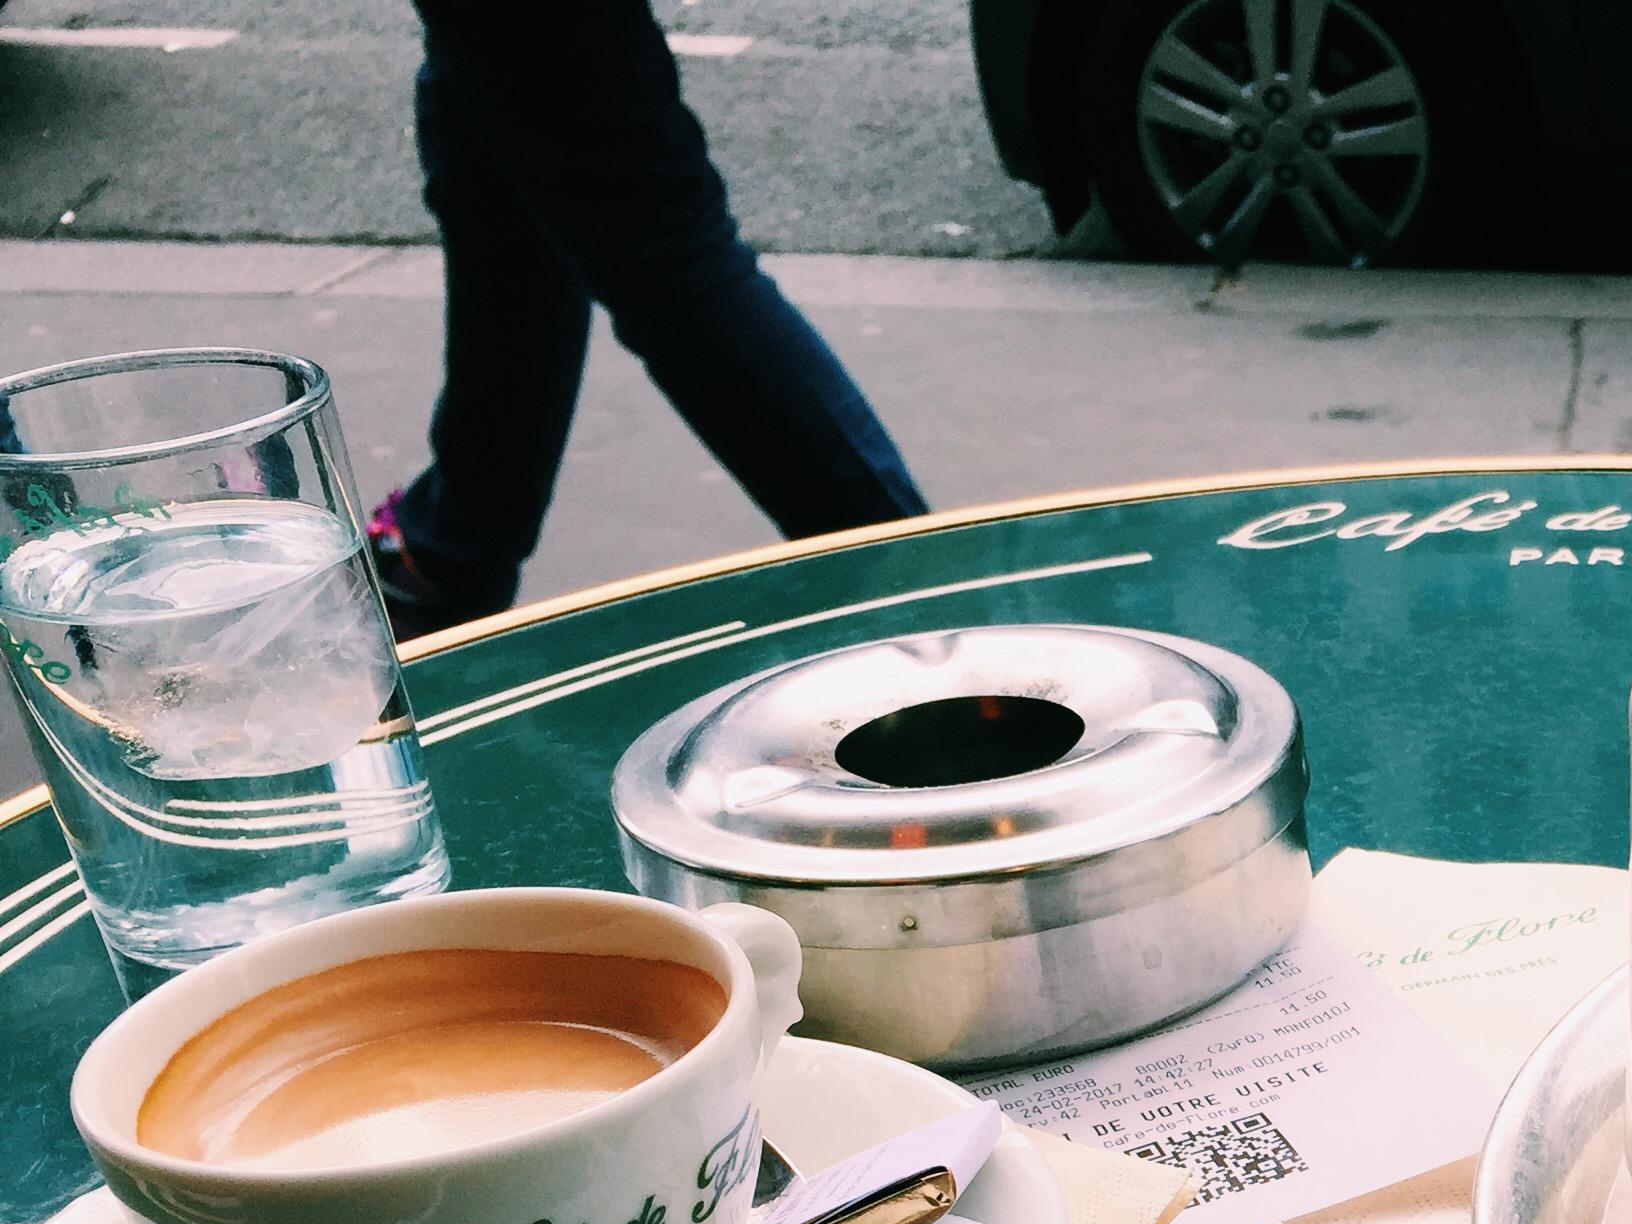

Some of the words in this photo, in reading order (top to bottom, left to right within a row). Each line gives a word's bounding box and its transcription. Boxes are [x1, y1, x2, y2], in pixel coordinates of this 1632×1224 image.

[1217, 489, 1538, 552] Café
[1545, 505, 1632, 531] de
[1400, 947, 1434, 966] de
[1447, 906, 1598, 956] Flore
[971, 1079, 1025, 1098] TOTAL
[1032, 1064, 1076, 1083] EURO
[1280, 990, 1328, 1017] 11.50
[1020, 1083, 1123, 1119] 24-02-2017
[1134, 1058, 1213, 1089] 14:42:27
[1092, 1119, 1126, 1138] DE
[1140, 1093, 1222, 1122] VOTRE
[1237, 1061, 1331, 1098] VISITE
